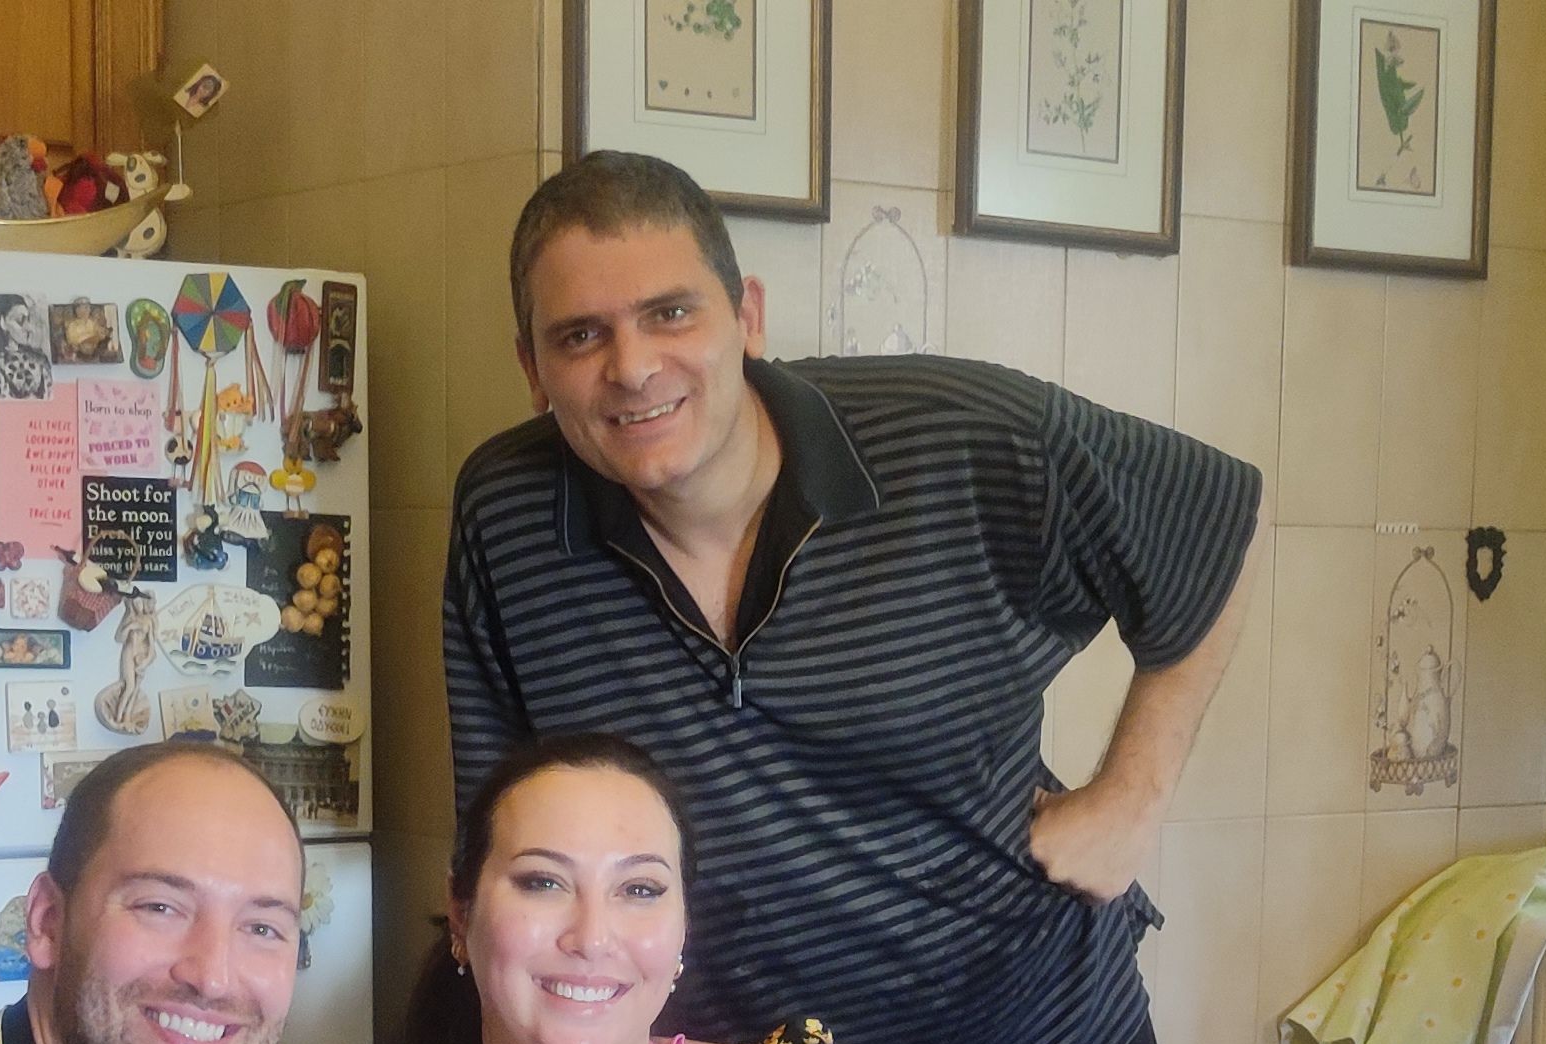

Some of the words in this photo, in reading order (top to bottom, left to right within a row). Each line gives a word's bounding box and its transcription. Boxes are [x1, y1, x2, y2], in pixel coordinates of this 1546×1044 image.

[85, 400, 111, 415] Born
[114, 406, 126, 416] to
[128, 402, 152, 421] shop
[29, 420, 43, 430] ALL
[88, 439, 133, 453] FORCED
[135, 438, 150, 448] TO
[103, 453, 138, 465] WORK
[37, 479, 65, 489] OTHER
[86, 482, 140, 502] Shoot
[144, 484, 172, 503] for
[52, 508, 72, 520] LOVE
[88, 504, 117, 522] the
[147, 530, 173, 545] you
[149, 545, 173, 557] land
